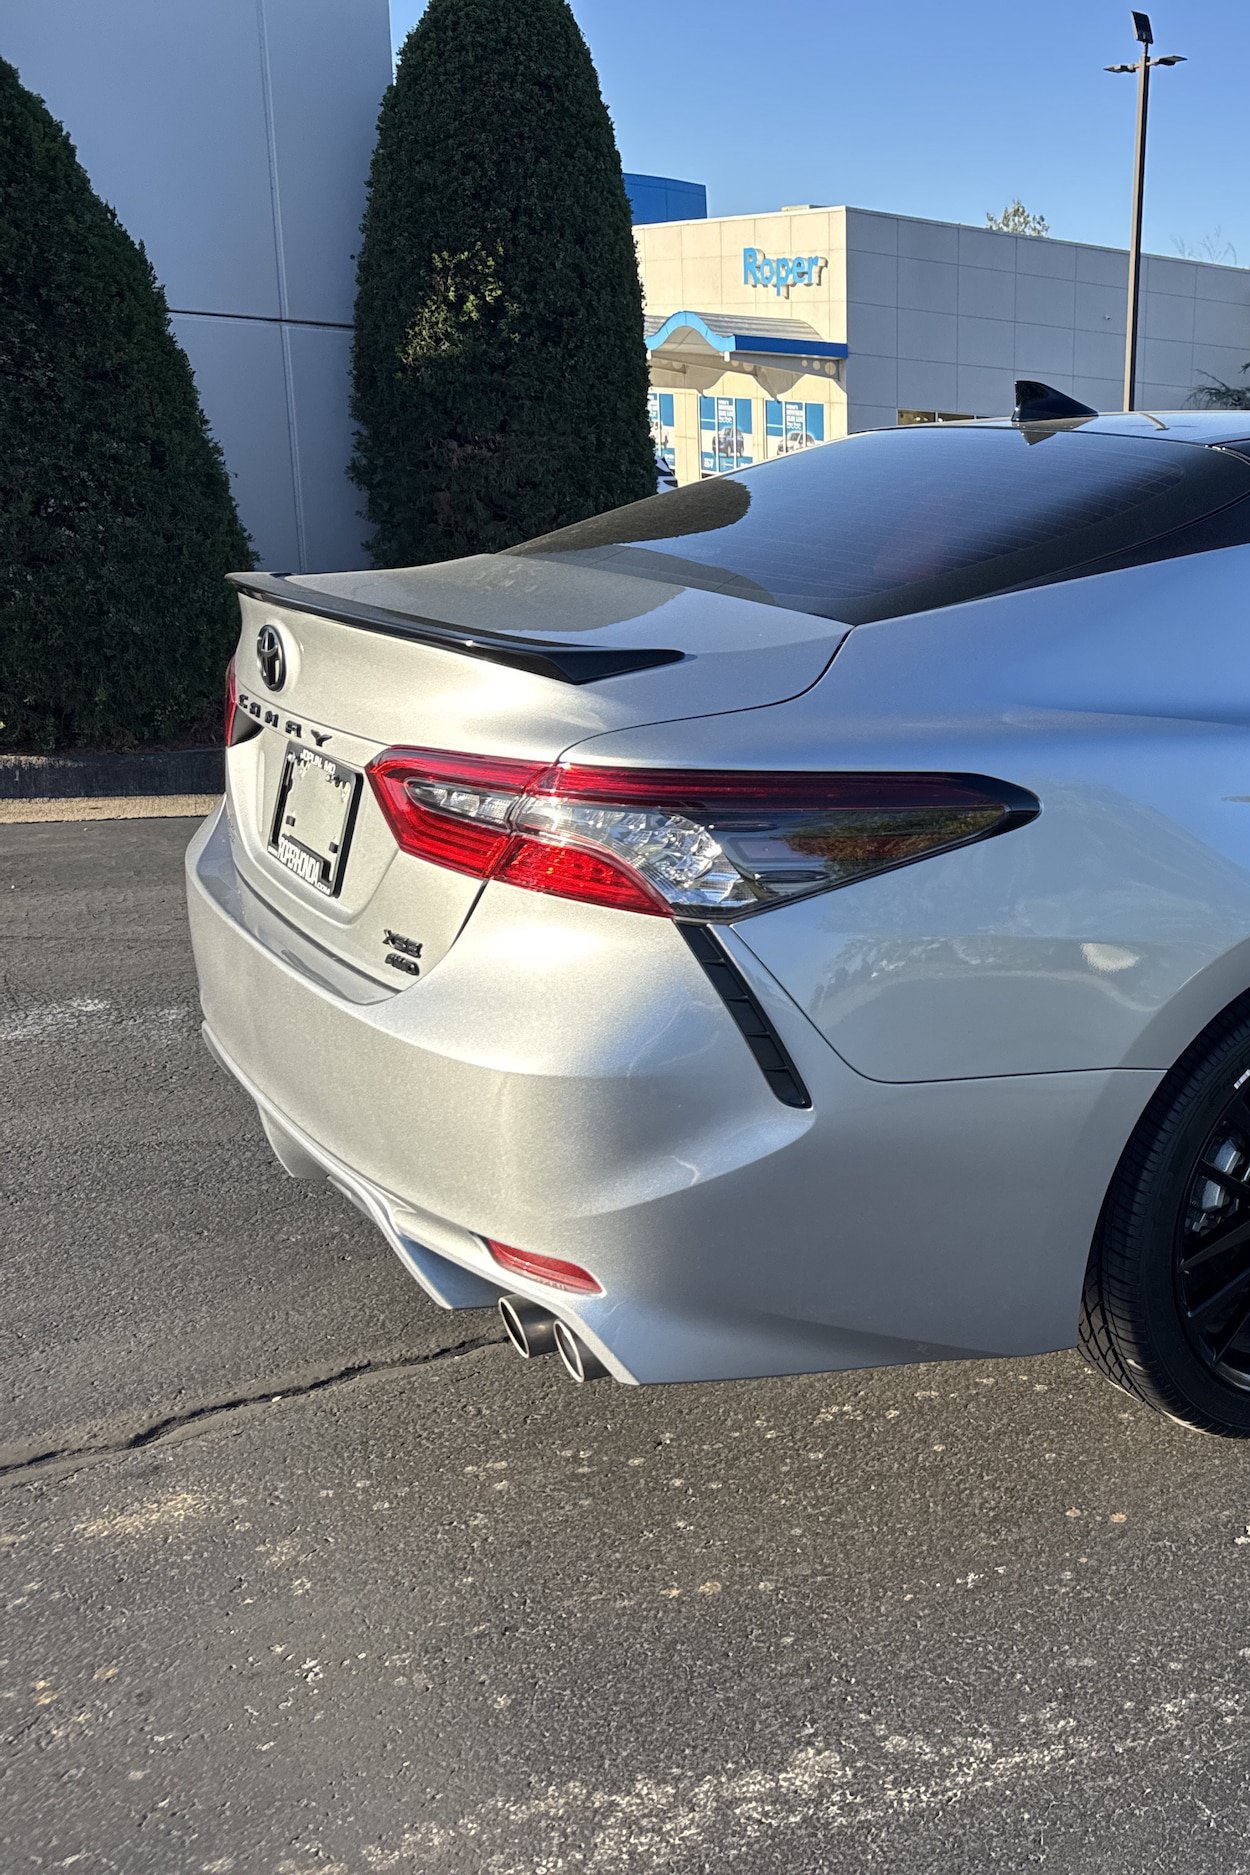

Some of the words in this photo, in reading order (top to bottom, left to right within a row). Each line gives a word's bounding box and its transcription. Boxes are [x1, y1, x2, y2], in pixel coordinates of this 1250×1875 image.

[743, 247, 824, 298] Roper
[239, 694, 332, 747] CAMRY
[324, 760, 336, 774] MO
[382, 929, 423, 958] XSE
[385, 953, 420, 976] AWD
